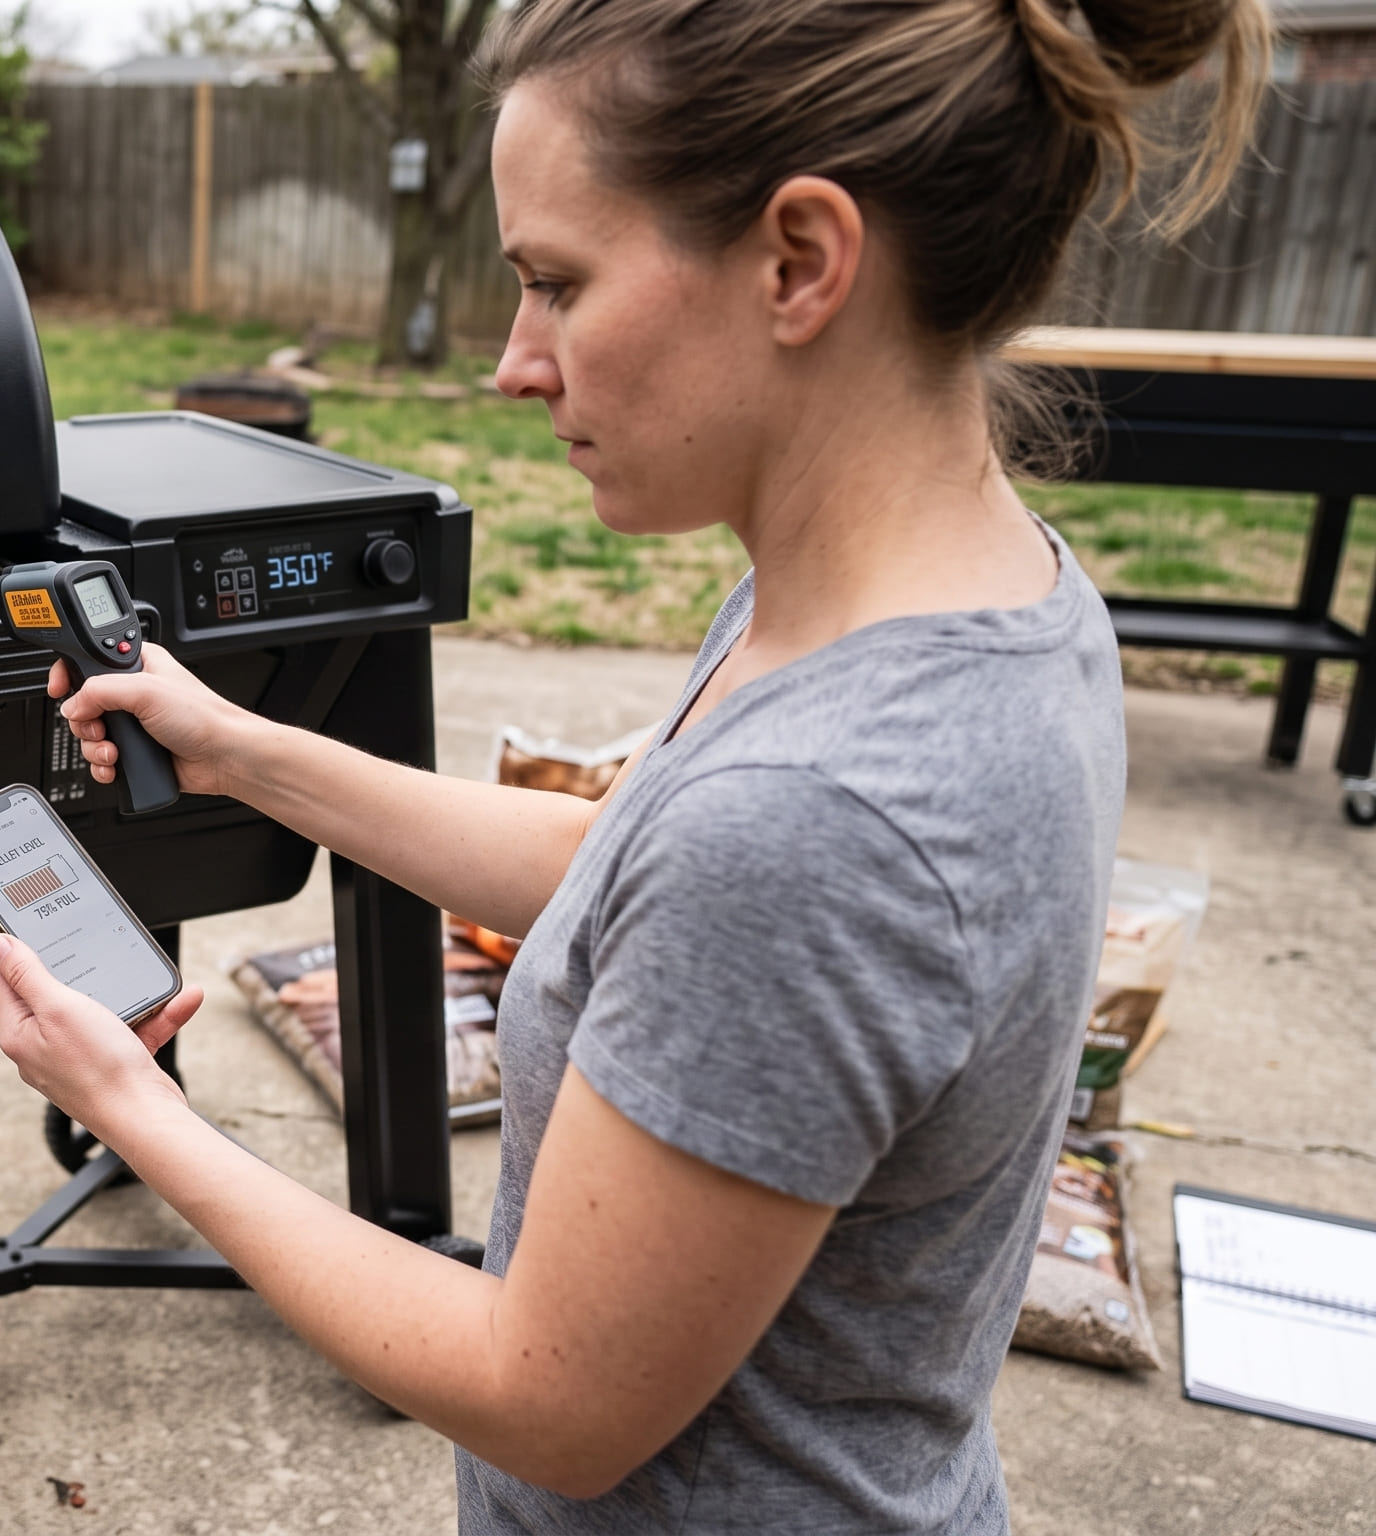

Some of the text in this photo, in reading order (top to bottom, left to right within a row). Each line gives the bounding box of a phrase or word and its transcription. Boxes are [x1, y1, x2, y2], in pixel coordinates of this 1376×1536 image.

[267, 551, 333, 589] 350°F
[19, 837, 45, 854] LEVEL
[54, 891, 80, 909] FULL
